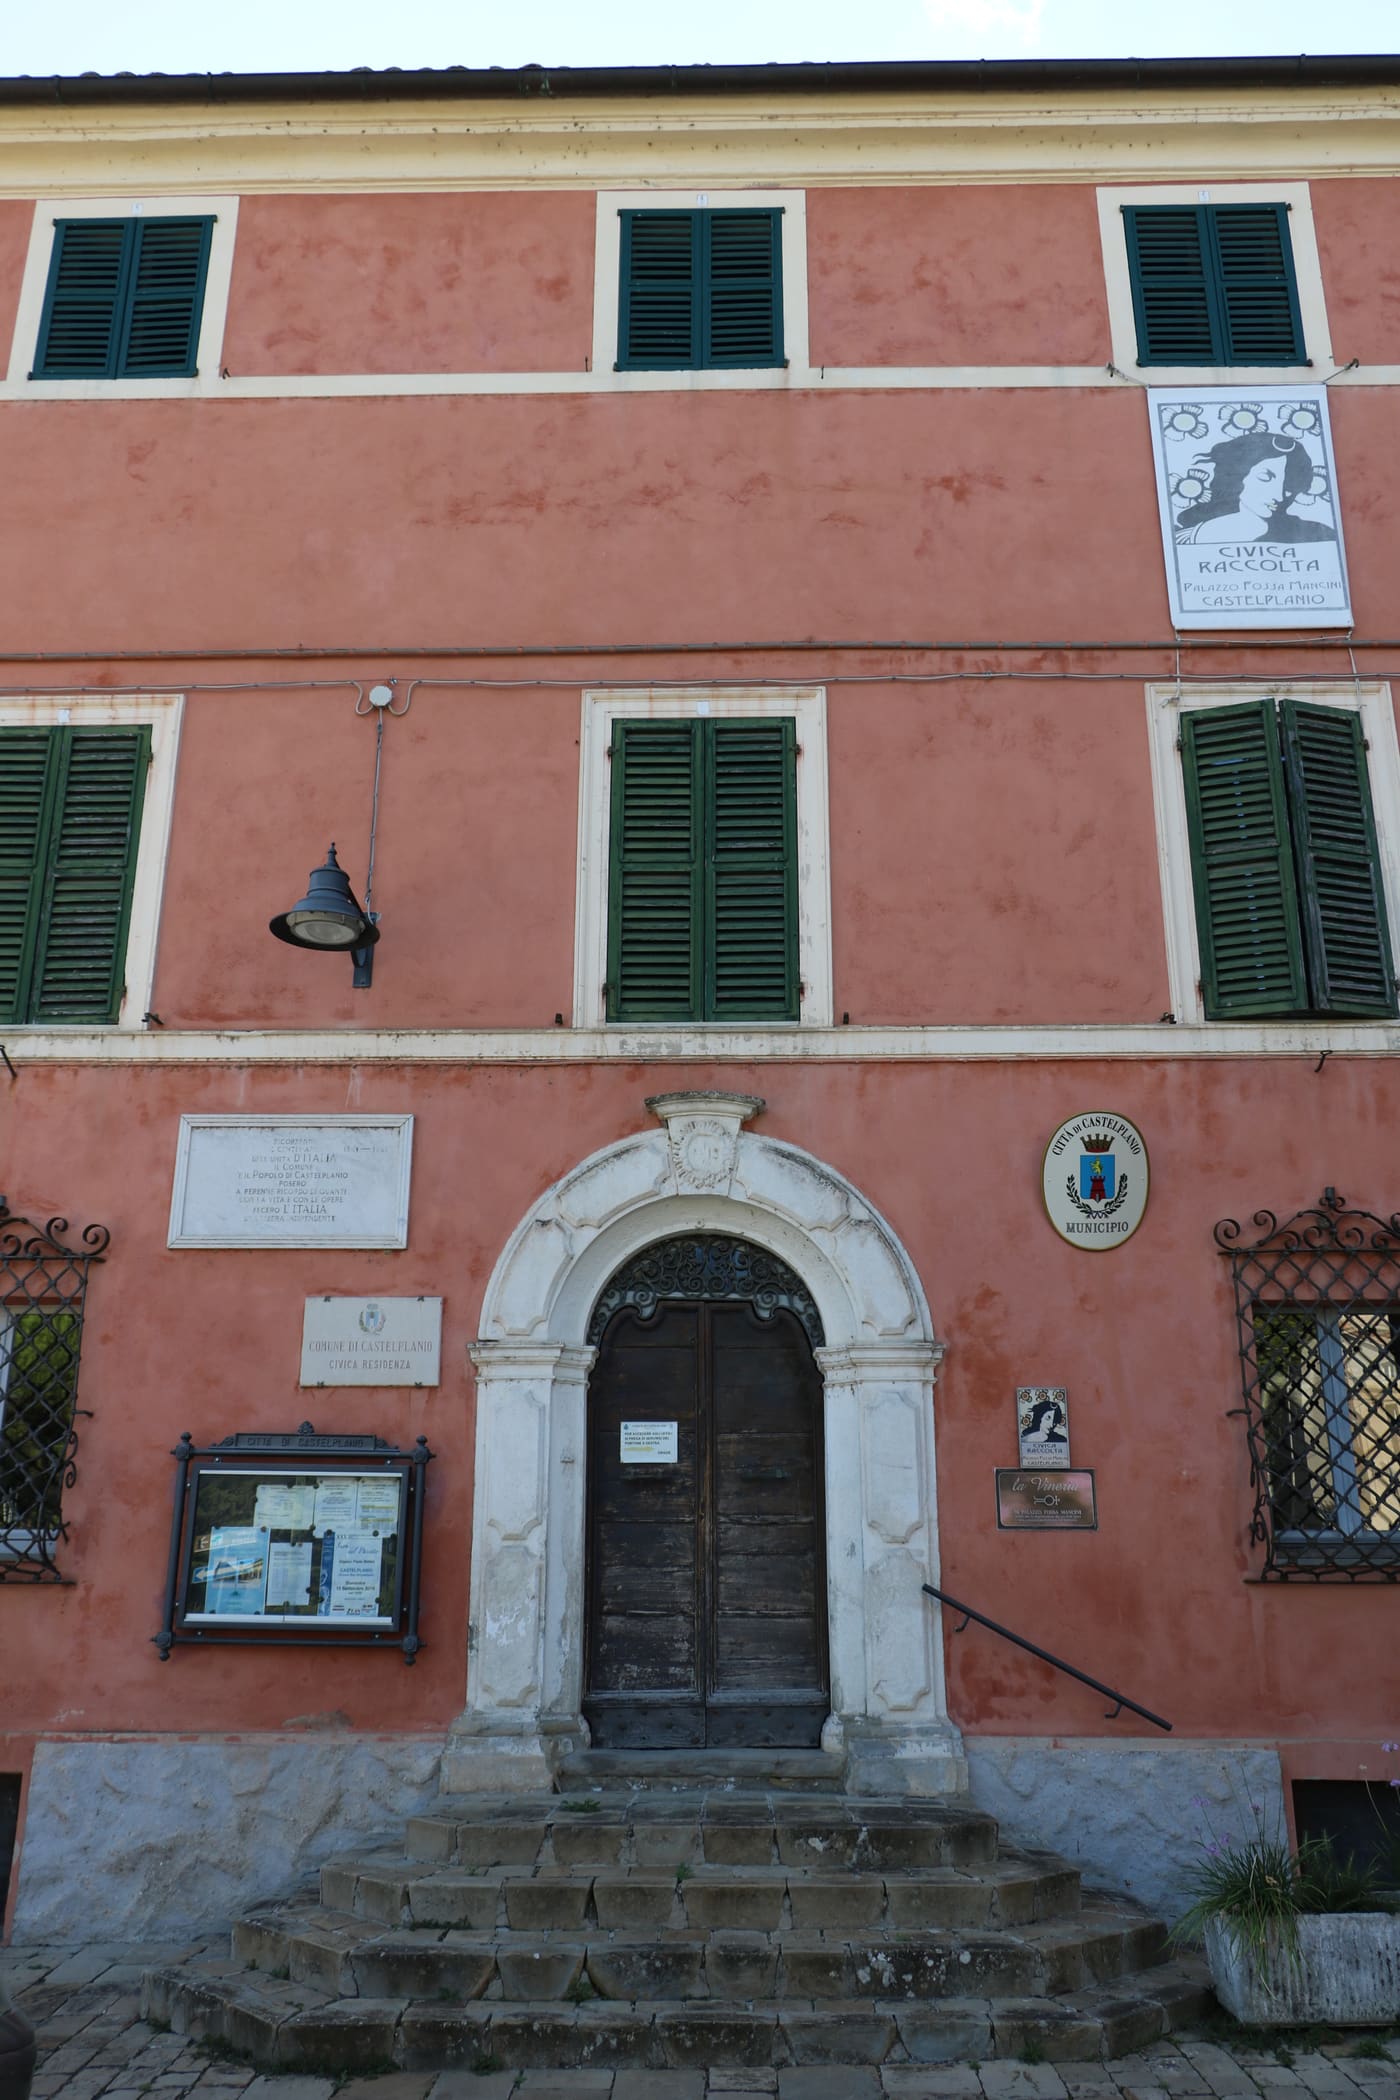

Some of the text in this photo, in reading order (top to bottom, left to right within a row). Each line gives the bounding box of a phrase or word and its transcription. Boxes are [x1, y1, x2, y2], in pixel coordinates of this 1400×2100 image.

[1218, 546, 1296, 558] CIVICA
[1199, 559, 1320, 573] RACCOLTA
[1202, 594, 1325, 606] CASTELPLANIO
[1072, 1124, 1082, 1134] DI
[1081, 1116, 1142, 1155] CASTELPLANIO
[252, 1170, 284, 1179] POPOLO
[294, 1170, 349, 1179] CASTELPLANIO
[1066, 1221, 1129, 1233] MUNICIPIO
[308, 1339, 433, 1352] COMUNE DI CASTELPLANIO
[328, 1359, 411, 1369] CIVICA RESIDENZA
